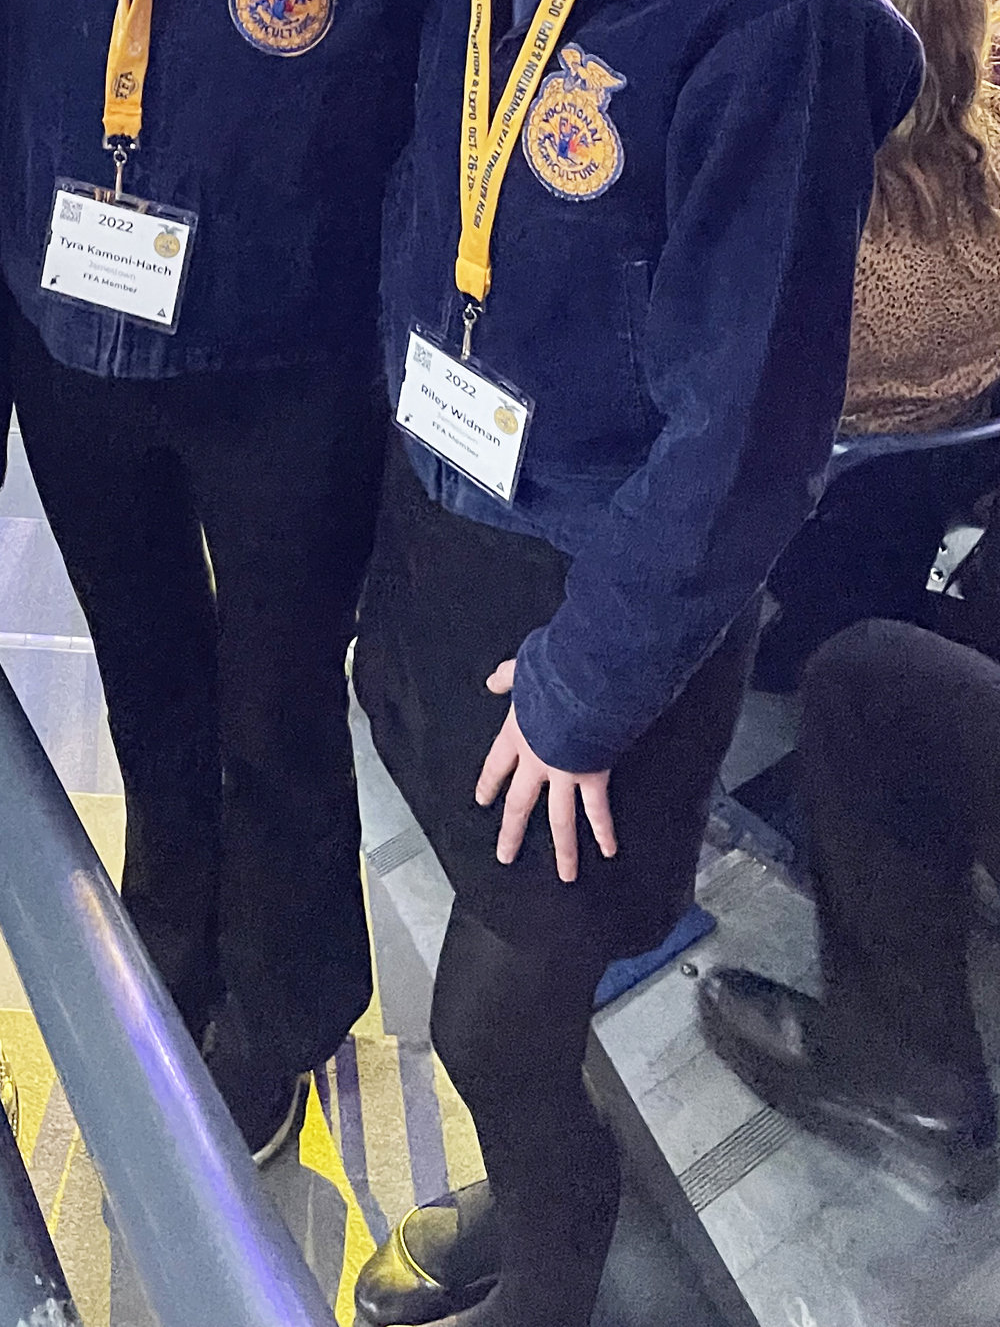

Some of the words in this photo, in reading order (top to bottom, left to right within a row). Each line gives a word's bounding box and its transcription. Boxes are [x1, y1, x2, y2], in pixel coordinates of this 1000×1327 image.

[534, 20, 554, 51] EXPO
[531, 51, 543, 61] &
[115, 71, 133, 99] FFA
[542, 102, 602, 143] VOCATIONAL
[480, 150, 501, 201] NATIONAL
[98, 214, 134, 234] 2022
[59, 236, 84, 252] Tyra
[87, 244, 172, 277] Kamoni-Hatch
[89, 260, 136, 282] Jamestown
[83, 272, 100, 284] FFA
[101, 277, 138, 294] Member
[445, 369, 477, 398] 2022
[421, 384, 448, 410] Riley
[447, 407, 501, 447] Widman
[432, 421, 447, 436] FFA
[449, 432, 479, 458] Member
